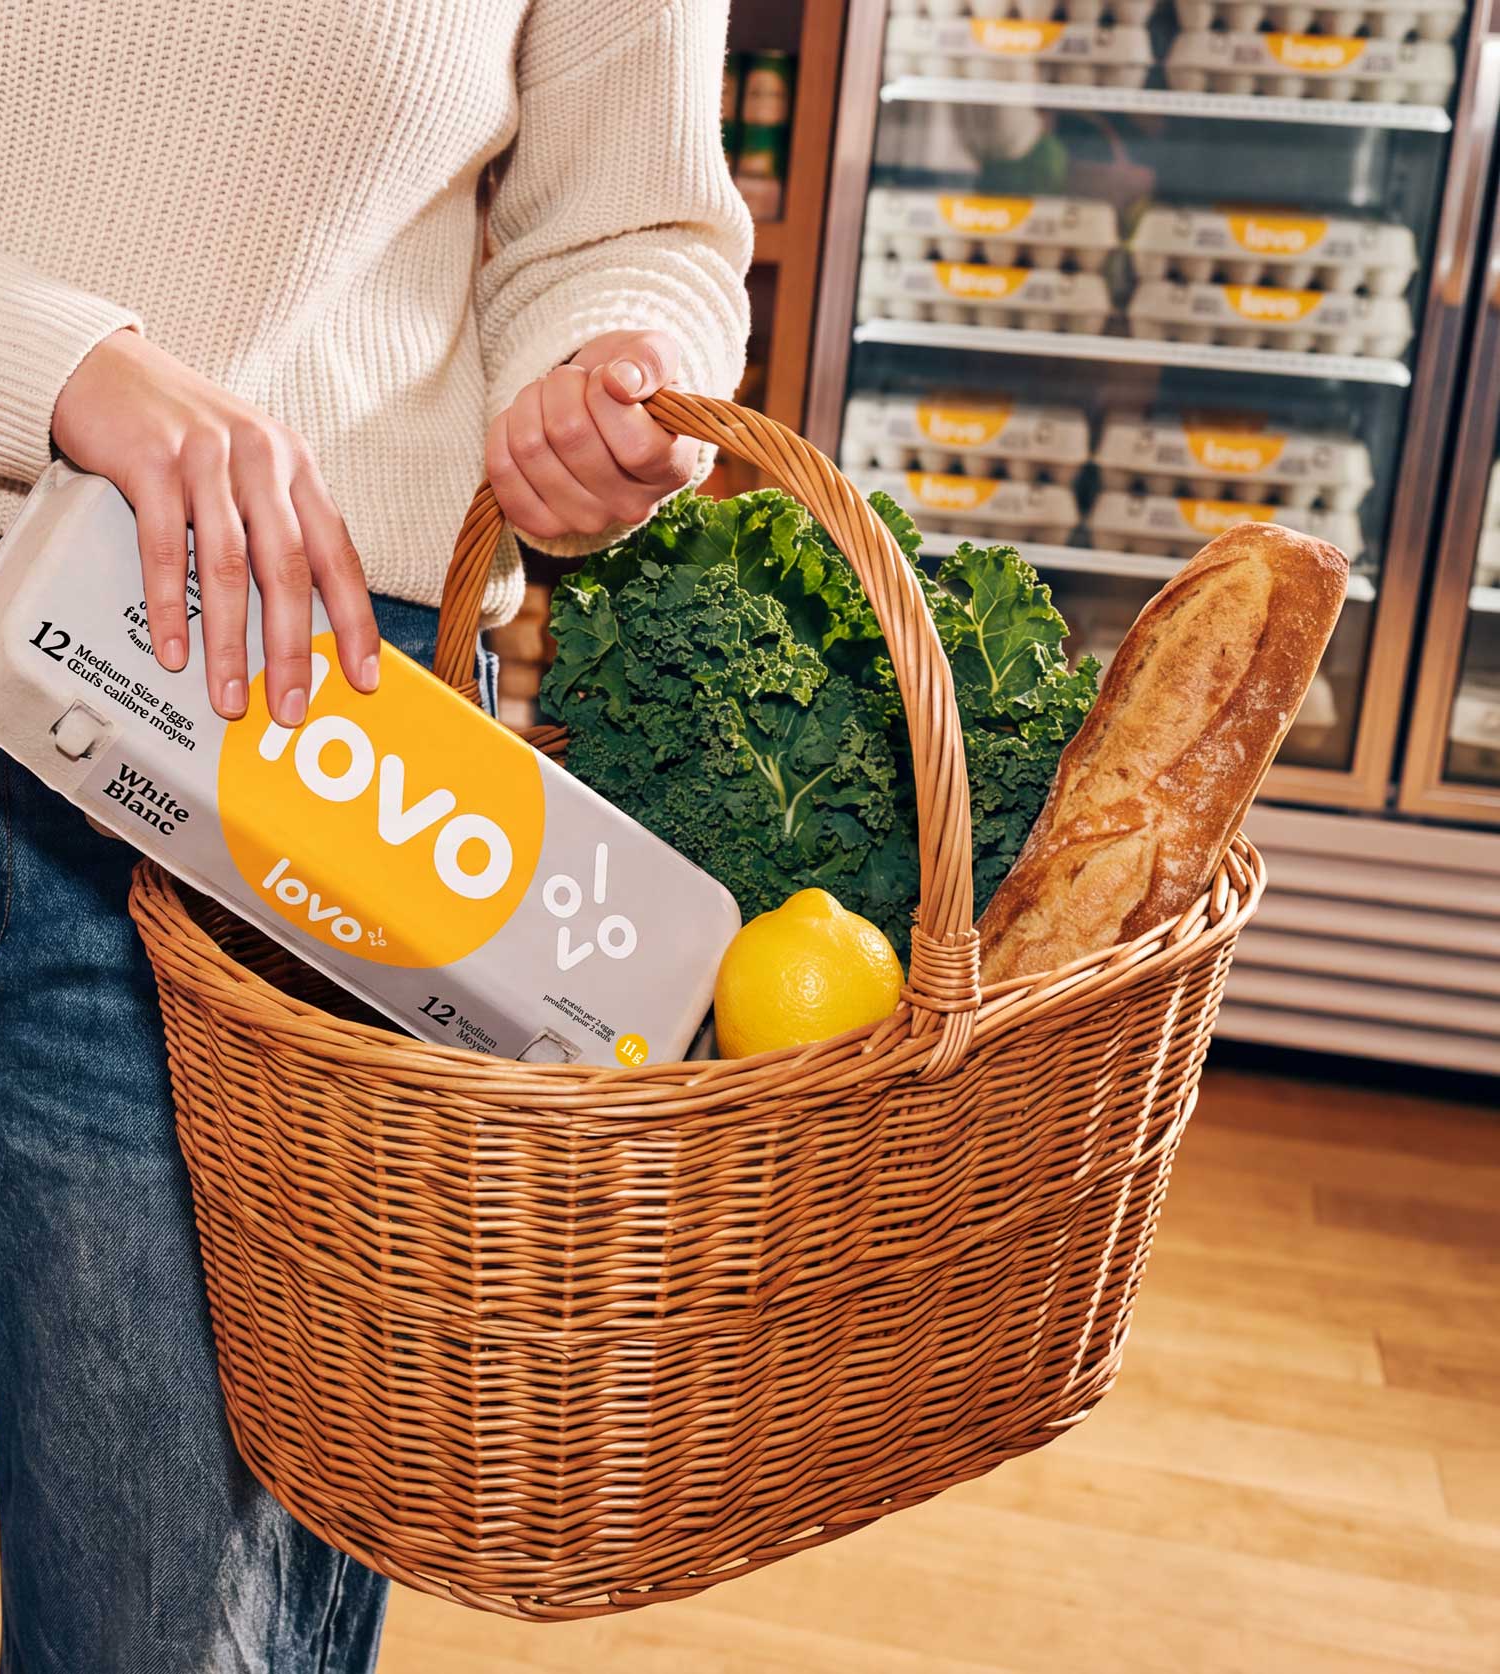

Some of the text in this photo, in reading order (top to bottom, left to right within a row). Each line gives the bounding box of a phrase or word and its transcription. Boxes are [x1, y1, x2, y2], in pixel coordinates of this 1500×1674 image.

[29, 620, 72, 662] 12
[66, 658, 196, 752] Œufs calibre moyen
[74, 643, 195, 731] Medium Size Eggs
[102, 778, 175, 836] Blanc
[117, 762, 190, 823] White
[262, 857, 362, 943] lovo
[417, 996, 457, 1027] 12
[455, 1015, 498, 1049] Medium
[560, 996, 617, 1037] protein per 2 eggs
[572, 1013, 591, 1028] pour
[588, 1025, 596, 1033] 2
